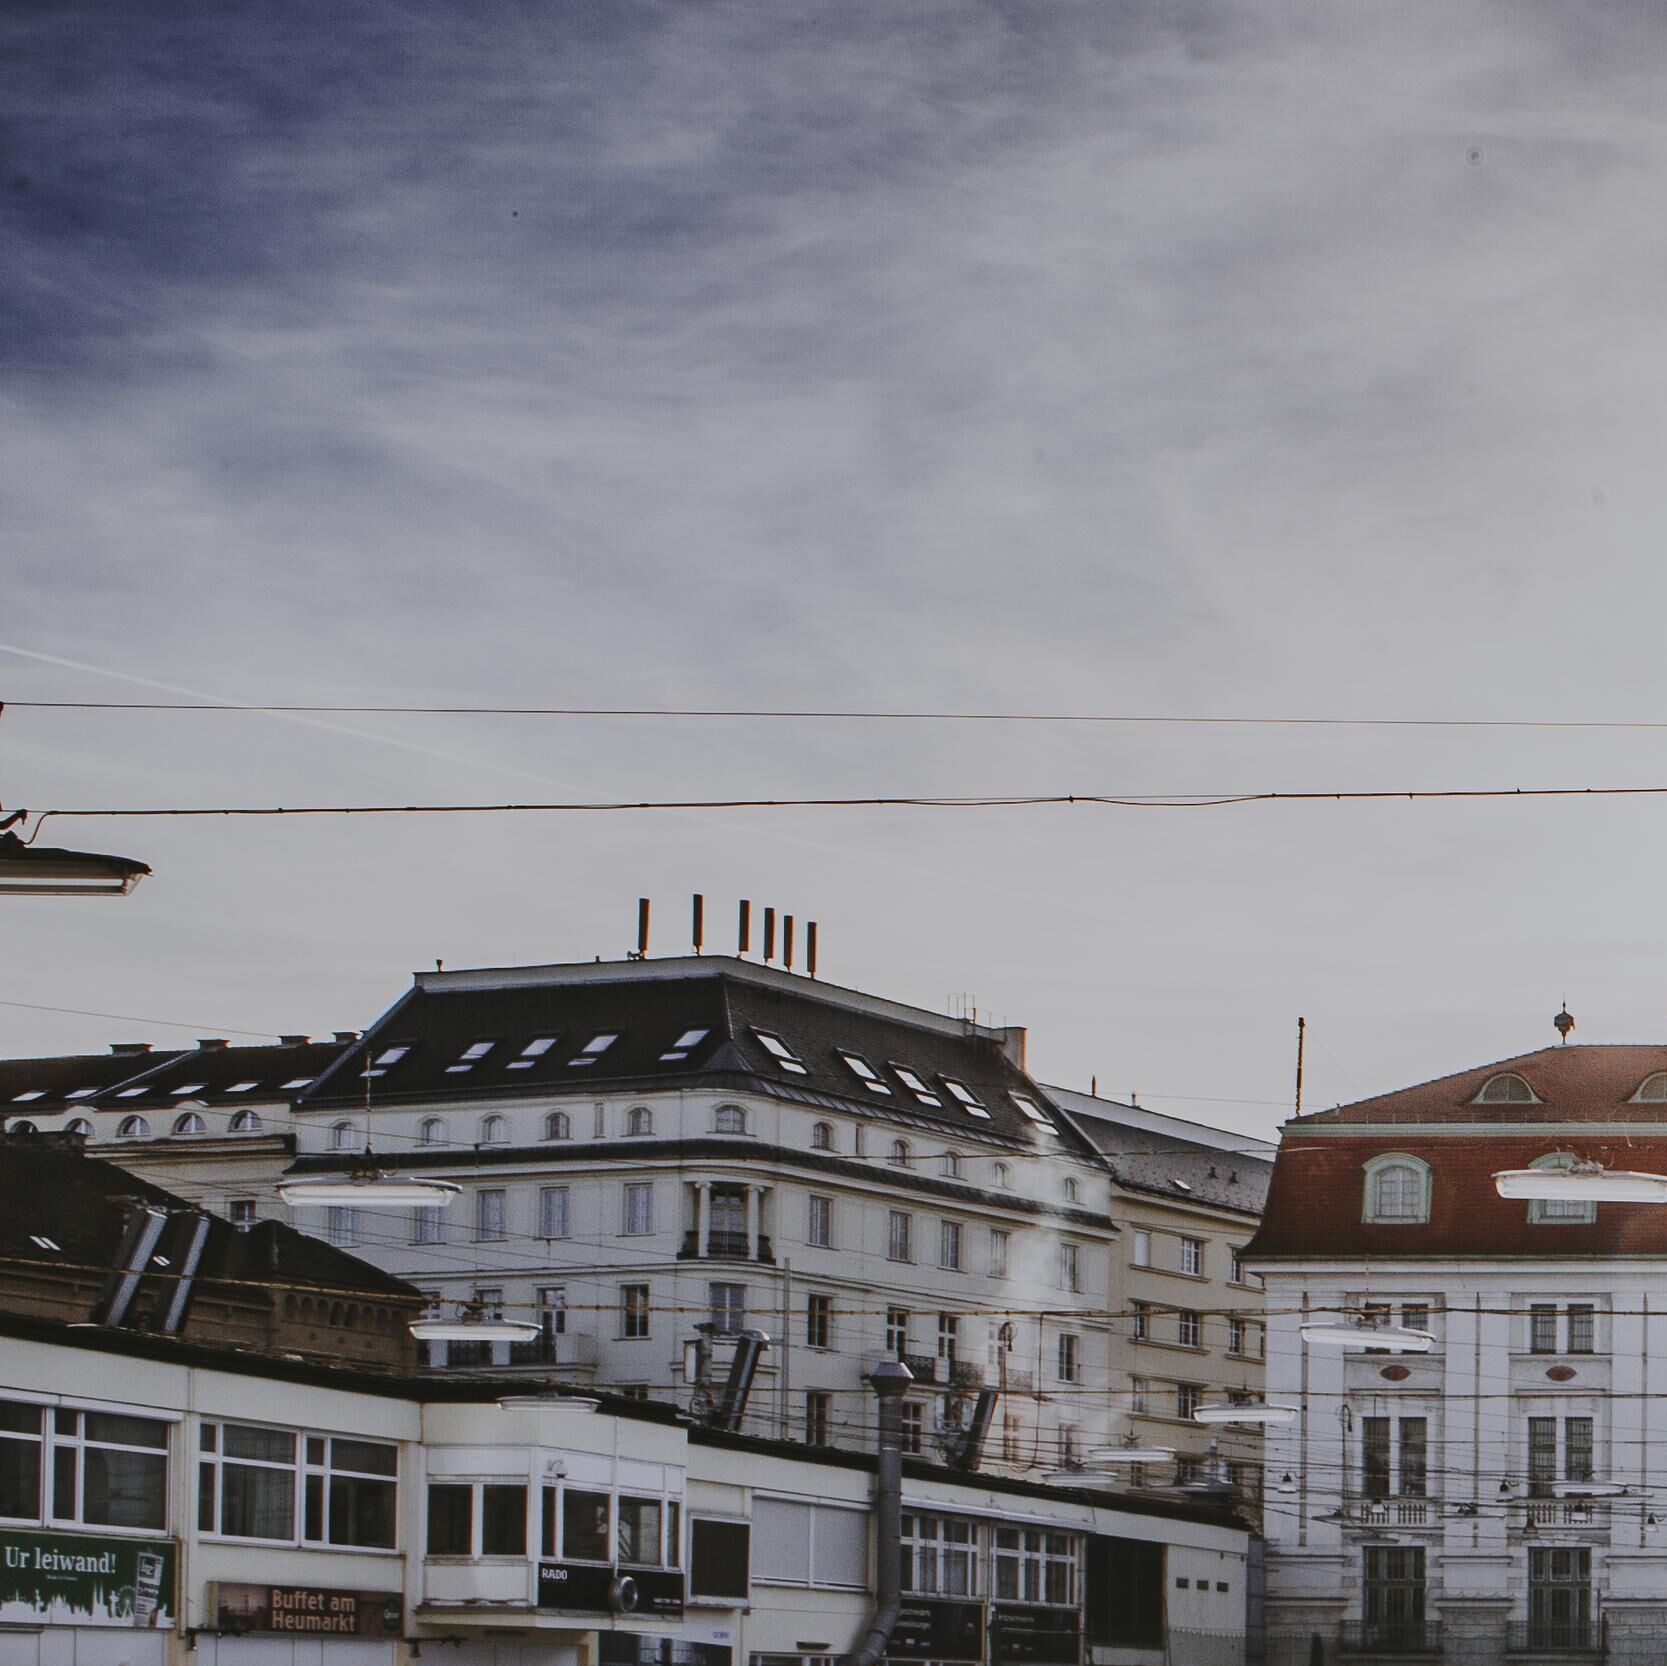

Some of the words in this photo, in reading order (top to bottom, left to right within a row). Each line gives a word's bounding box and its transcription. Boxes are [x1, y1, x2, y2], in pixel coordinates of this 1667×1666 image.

[4, 1546, 31, 1568] Ur
[34, 1547, 117, 1574] leiwand!
[541, 1567, 568, 1581] RADO
[271, 1589, 325, 1610] Buffet
[329, 1597, 356, 1612] am
[271, 1610, 356, 1632] Heumarkt
